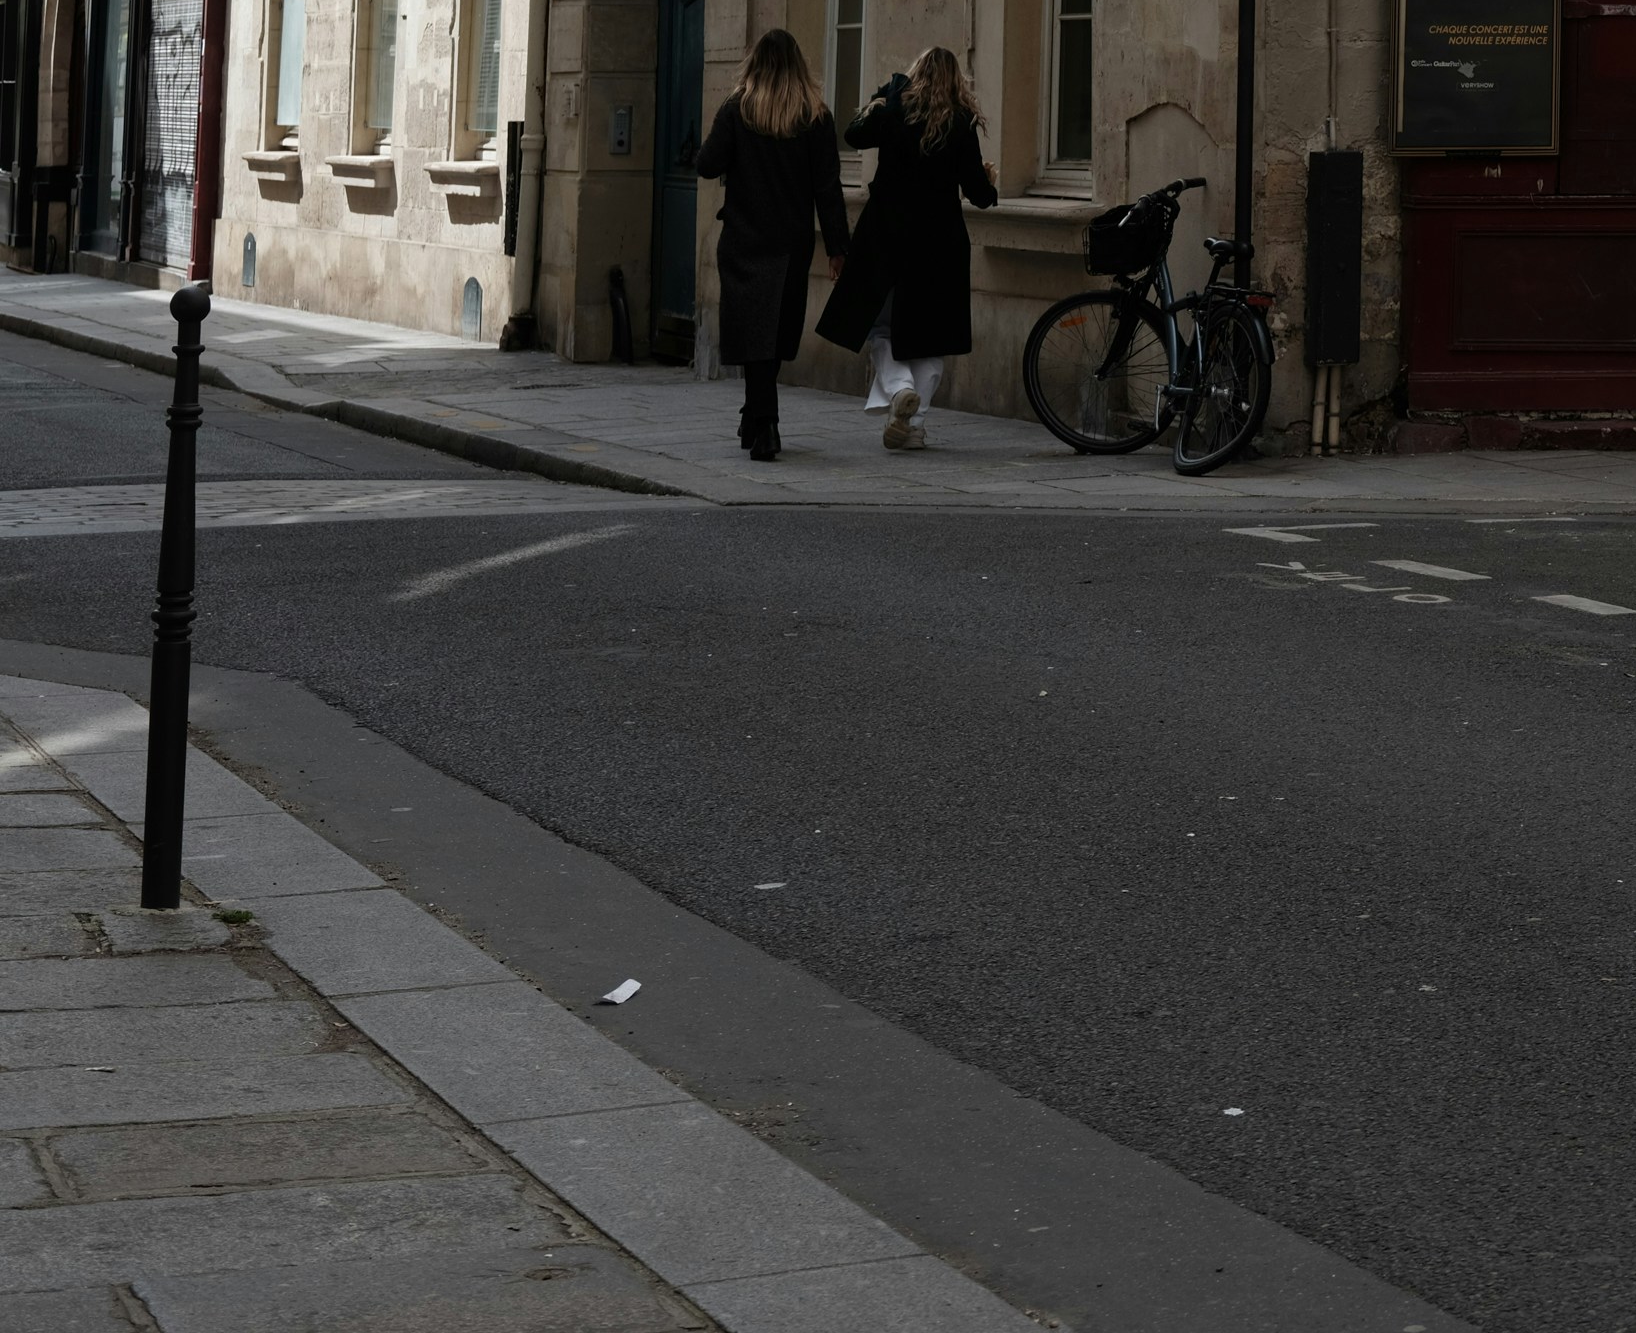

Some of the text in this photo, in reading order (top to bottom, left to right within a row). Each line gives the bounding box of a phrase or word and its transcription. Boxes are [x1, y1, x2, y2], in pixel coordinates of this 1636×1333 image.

[1429, 25, 1548, 34] CHAQUE CONCERT EST UNE
[1448, 34, 1548, 45] NOUVELLE EXPÉRIENCE
